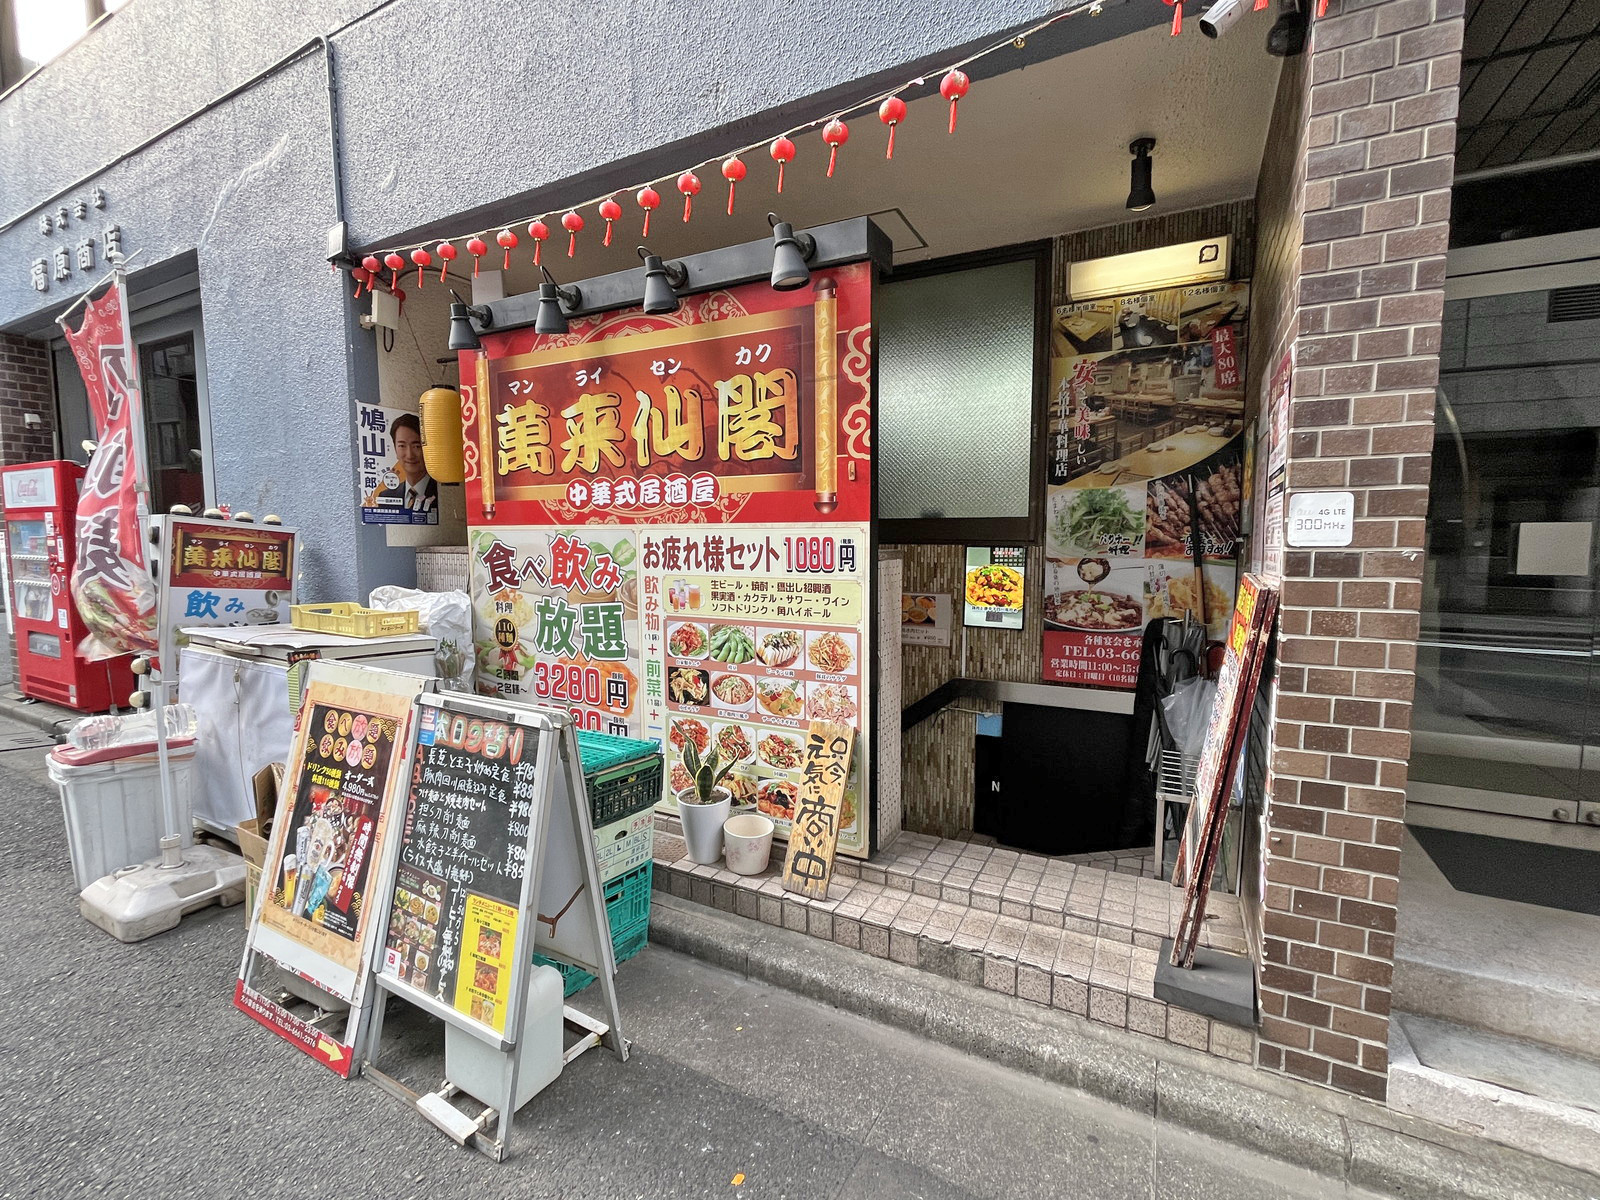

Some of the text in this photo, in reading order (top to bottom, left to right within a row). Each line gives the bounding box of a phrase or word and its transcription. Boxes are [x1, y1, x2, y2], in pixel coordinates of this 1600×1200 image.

[508, 343, 772, 395] マン ライ セン カク
[1214, 328, 1237, 386] 最大80席
[497, 367, 799, 476] 萬来仙閣
[1054, 376, 1071, 477] 本格中華料理店
[1072, 358, 1098, 466] 安くて美味しい
[361, 406, 387, 490] 鳩山紀一郎
[568, 474, 717, 506] 中華式居酒屋
[1318, 508, 1331, 516] 4G
[1333, 508, 1346, 516] LTE
[481, 533, 624, 596] 食べ飲み
[643, 534, 780, 573] お疲れ様セット
[184, 589, 245, 619] 飲み
[495, 601, 513, 614] 料理
[534, 595, 629, 662] 放題
[643, 575, 660, 632] 飲み物
[711, 602, 831, 618] ソフトドリンク・角ハイボール
[646, 658, 662, 698] 前菜
[1050, 657, 1140, 674] 営業時間11:00～15:
